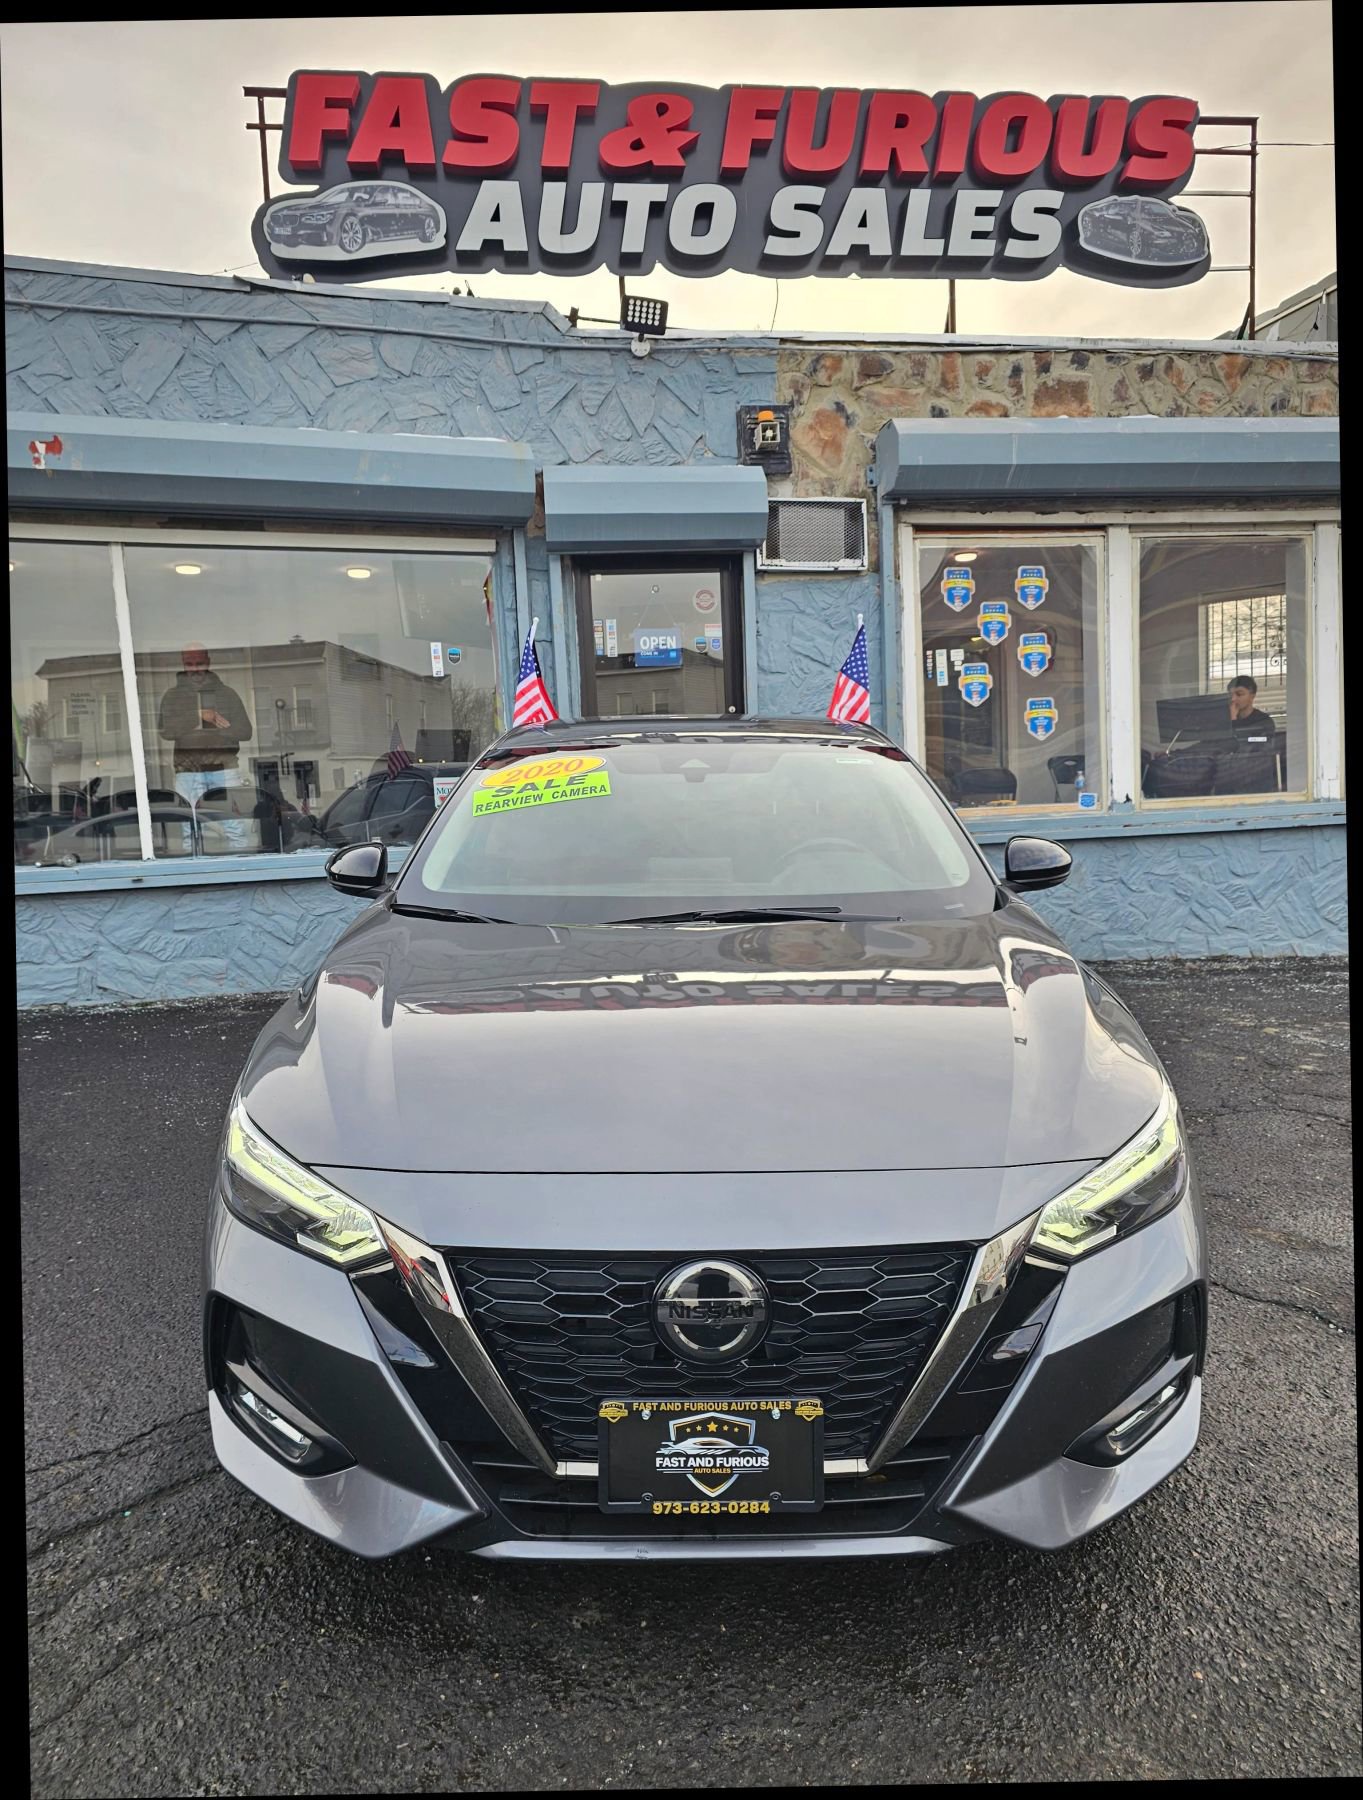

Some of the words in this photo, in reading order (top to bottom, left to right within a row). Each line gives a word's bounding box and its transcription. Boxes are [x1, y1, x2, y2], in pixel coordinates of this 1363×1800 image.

[287, 73, 600, 175] FAST
[599, 92, 700, 176] &
[720, 87, 1197, 185] FURIOUS
[455, 179, 738, 258] AUTO
[766, 188, 1064, 258] SALES
[640, 636, 676, 650] OPEN
[501, 759, 583, 784] 2020
[491, 774, 589, 797] SALE
[475, 793, 544, 813] REARVIEW
[551, 784, 607, 800] CAMERA
[669, 1304, 754, 1319] NISSAN
[633, 1402, 659, 1411] FAST
[660, 1402, 681, 1411] AND
[684, 1402, 728, 1411] FURIOUS
[730, 1401, 758, 1411] AUTO
[760, 1401, 791, 1410] SALES
[655, 1457, 688, 1468] FAST
[689, 1457, 714, 1467] AND
[716, 1456, 769, 1467] FURIOUS
[652, 1501, 770, 1514] 973-623-0284
